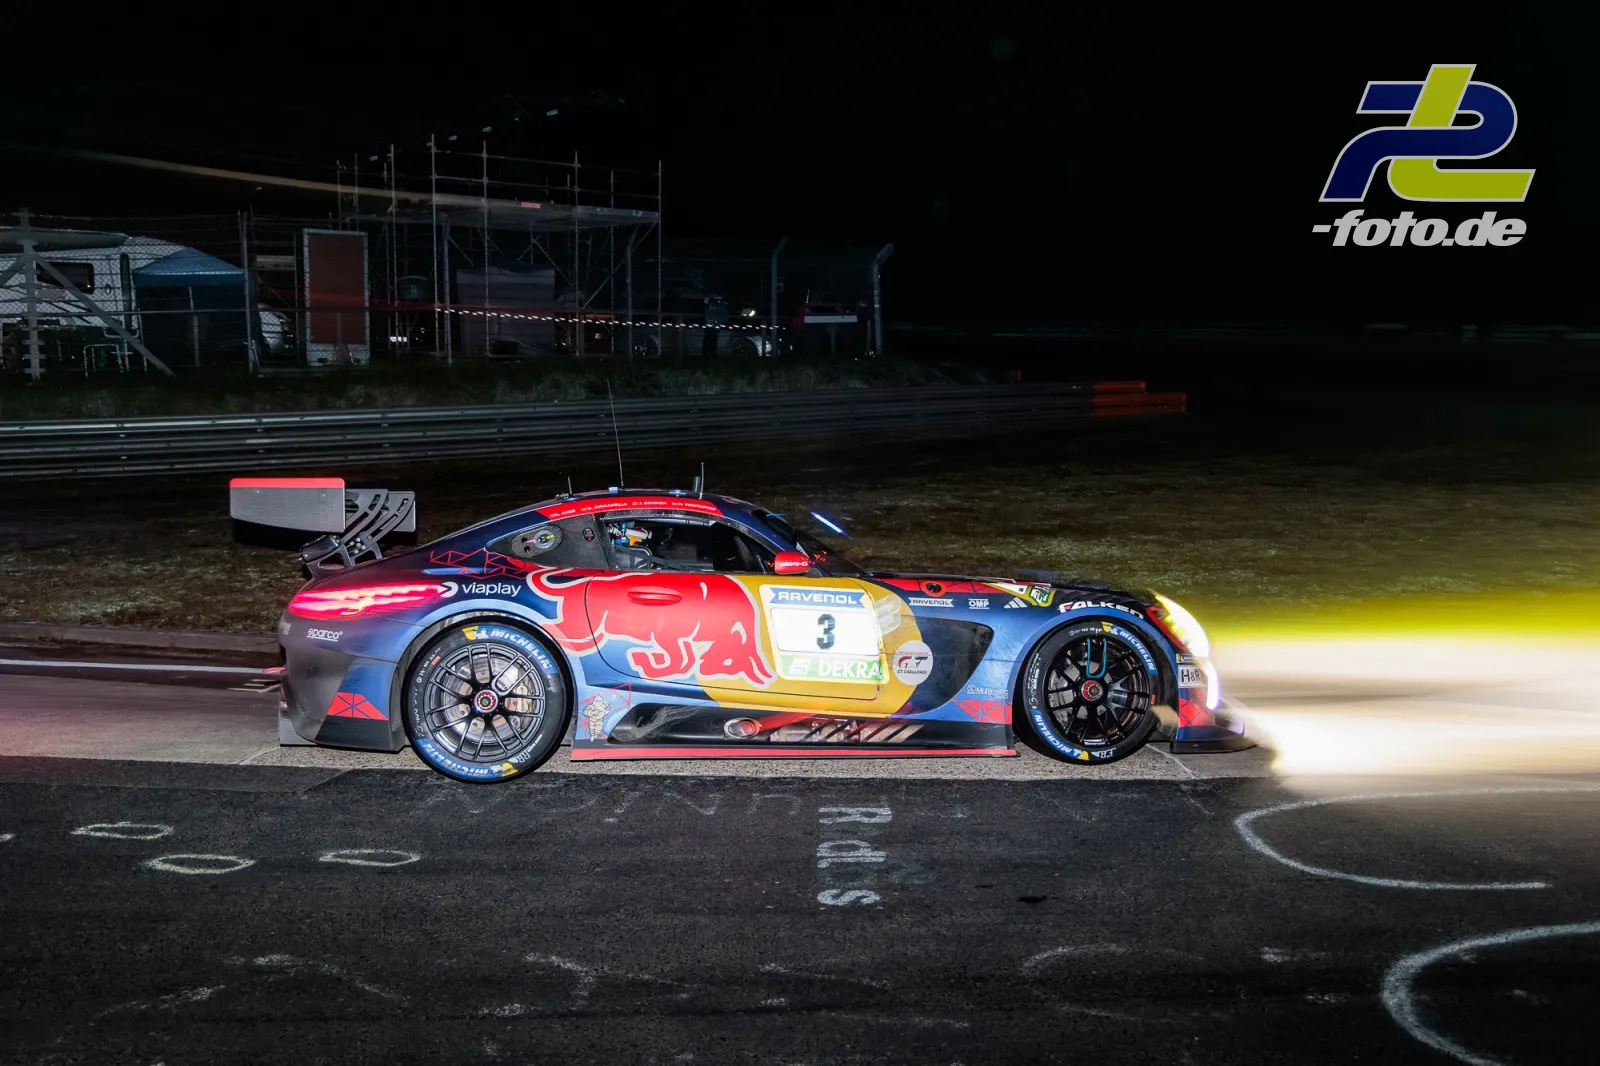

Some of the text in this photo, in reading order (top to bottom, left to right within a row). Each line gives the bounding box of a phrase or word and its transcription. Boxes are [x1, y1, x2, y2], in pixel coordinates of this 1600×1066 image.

[462, 582, 522, 597] viaplay
[778, 591, 858, 605] RAVENOL
[912, 598, 951, 606] RAVENOL
[968, 600, 990, 608] OMP
[1058, 601, 1145, 620] FALKEN
[816, 613, 836, 650] 3
[490, 628, 553, 671] MICHELIN
[1118, 630, 1156, 671] MICHELIN
[818, 657, 881, 680] DEKRA
[1034, 714, 1073, 754] MICHELIN
[422, 742, 489, 777] MICHELIN
